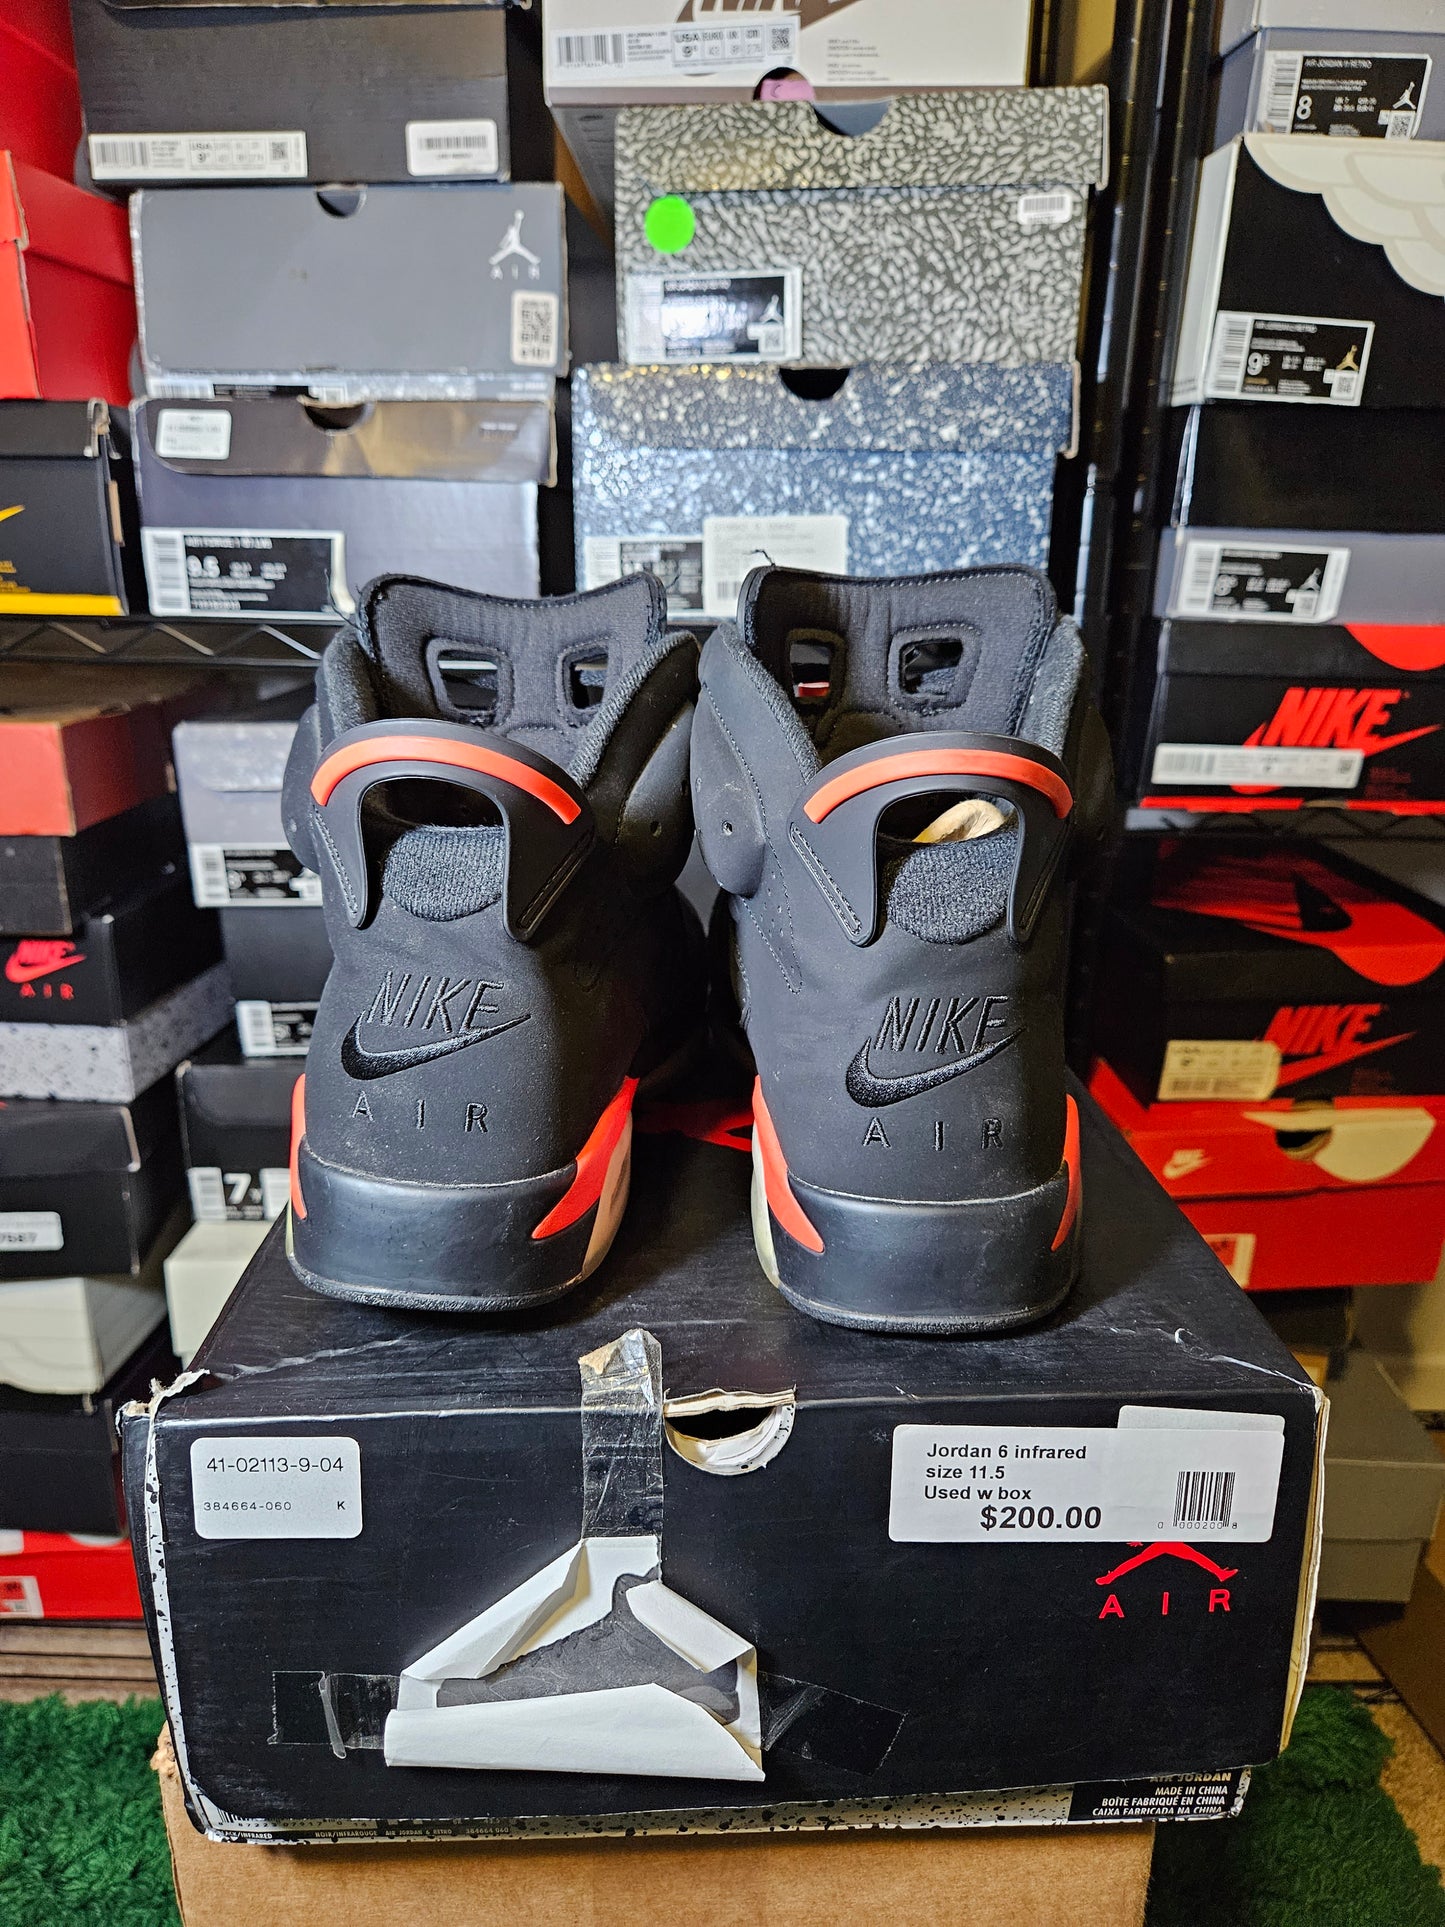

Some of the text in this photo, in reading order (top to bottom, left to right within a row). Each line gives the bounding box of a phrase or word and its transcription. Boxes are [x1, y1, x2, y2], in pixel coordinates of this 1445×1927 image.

[1297, 95, 1312, 120] 8
[1261, 686, 1401, 748] NIKE
[20, 982, 75, 1000] AIR
[366, 970, 504, 1036] NIKE
[874, 995, 1009, 1054] NIKE
[1262, 1003, 1383, 1056] NIKE
[351, 1090, 489, 1133] AIR
[863, 1116, 1004, 1151] AIR
[926, 1443, 1087, 1460] Jordan 6 infrared
[206, 1457, 344, 1473] 41-02113-9-04
[925, 1465, 1005, 1480] size 11.5
[924, 1485, 1032, 1500] Used w box
[203, 1501, 346, 1512] 384664-060 K
[979, 1504, 1102, 1532] $200.00
[1098, 1588, 1232, 1620] AIR
[1101, 1795, 1226, 1807] BOÎTE FABRIQUÉ EN CHINA
[1154, 1785, 1228, 1796] MADE IN CHINA
[1092, 1805, 1222, 1816] CAIXA FABRICADA NA CHINA
